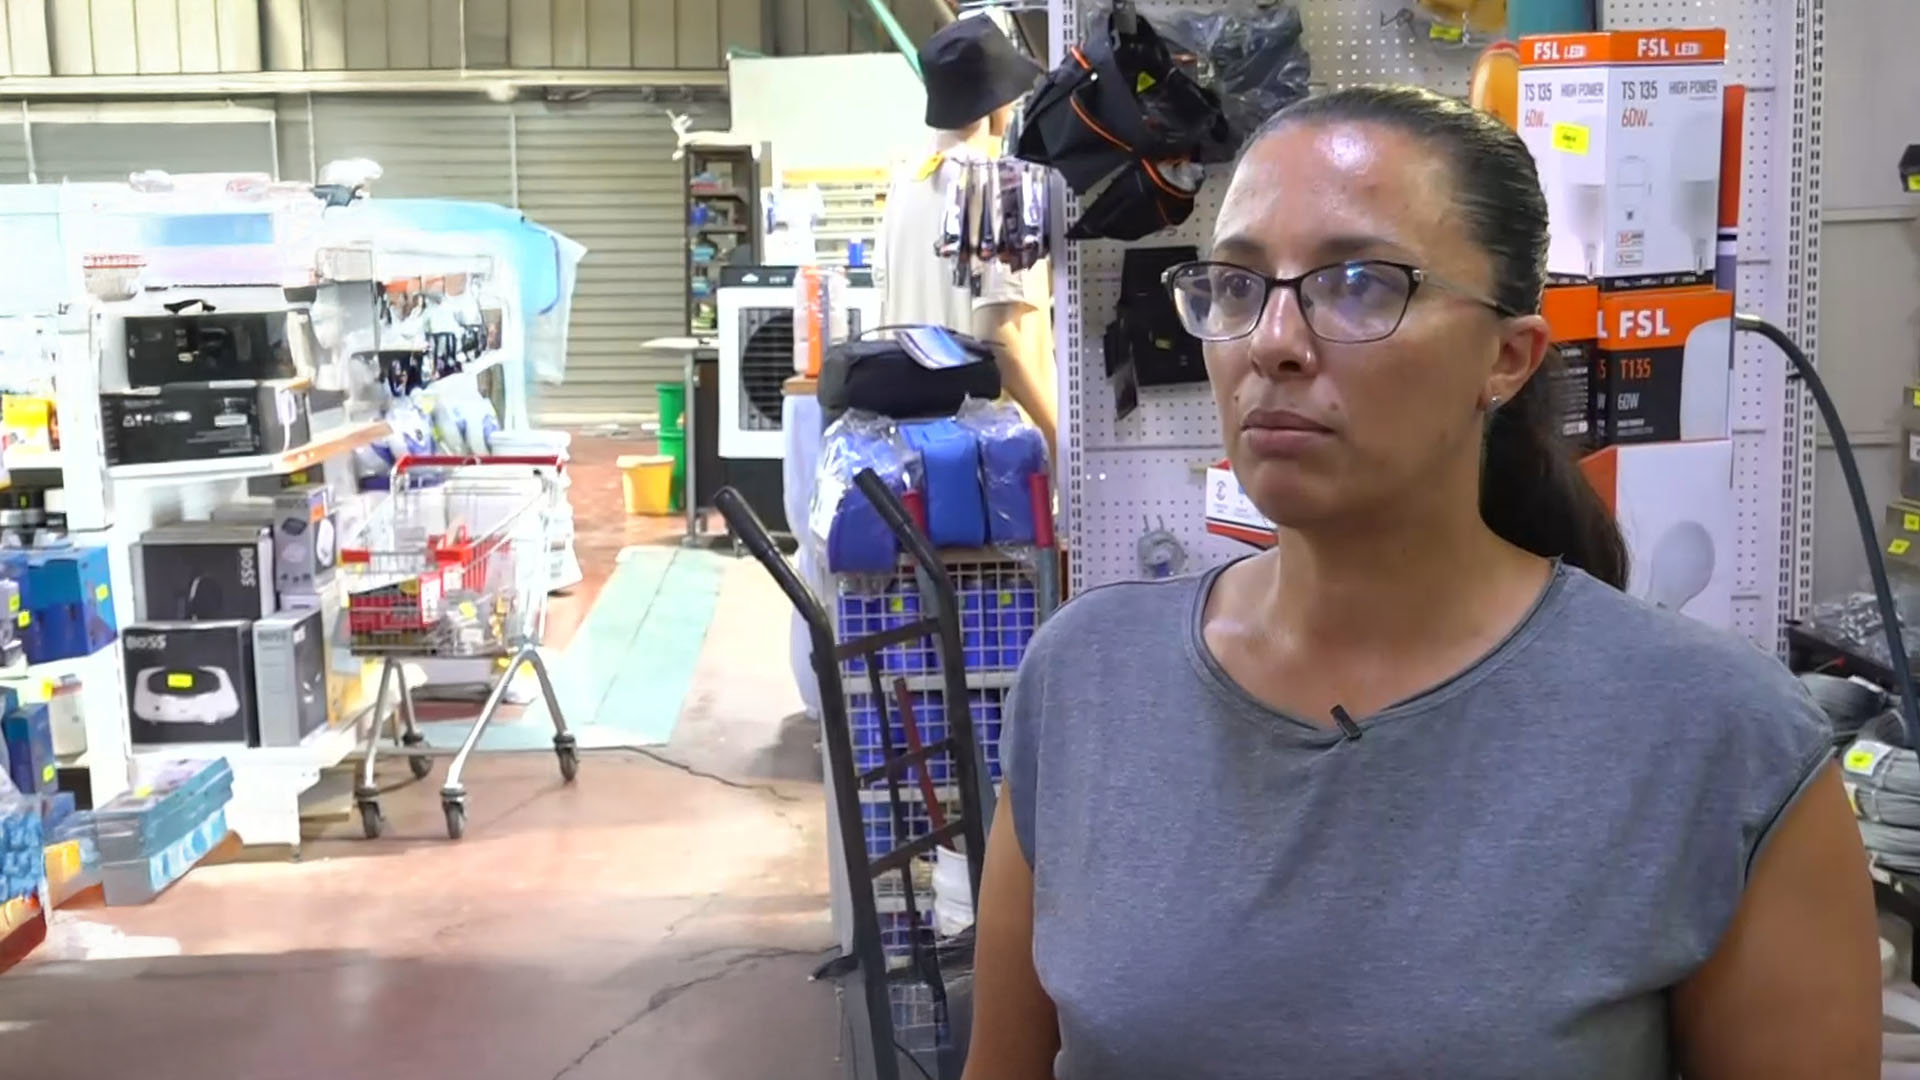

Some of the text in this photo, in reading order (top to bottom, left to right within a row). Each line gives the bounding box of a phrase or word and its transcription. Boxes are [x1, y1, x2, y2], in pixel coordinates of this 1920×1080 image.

[1534, 41, 1560, 60] FSL
[1637, 37, 1670, 58] FSL
[1524, 82, 1553, 102] TS 135
[1560, 81, 1604, 97] HIGH POWER
[1621, 80, 1658, 101] TS 135
[1669, 79, 1718, 95] HIGH POWER
[1621, 107, 1648, 128] 60W
[1619, 308, 1671, 338] FSL
[1620, 357, 1652, 380] T135
[1617, 392, 1640, 411] 60W
